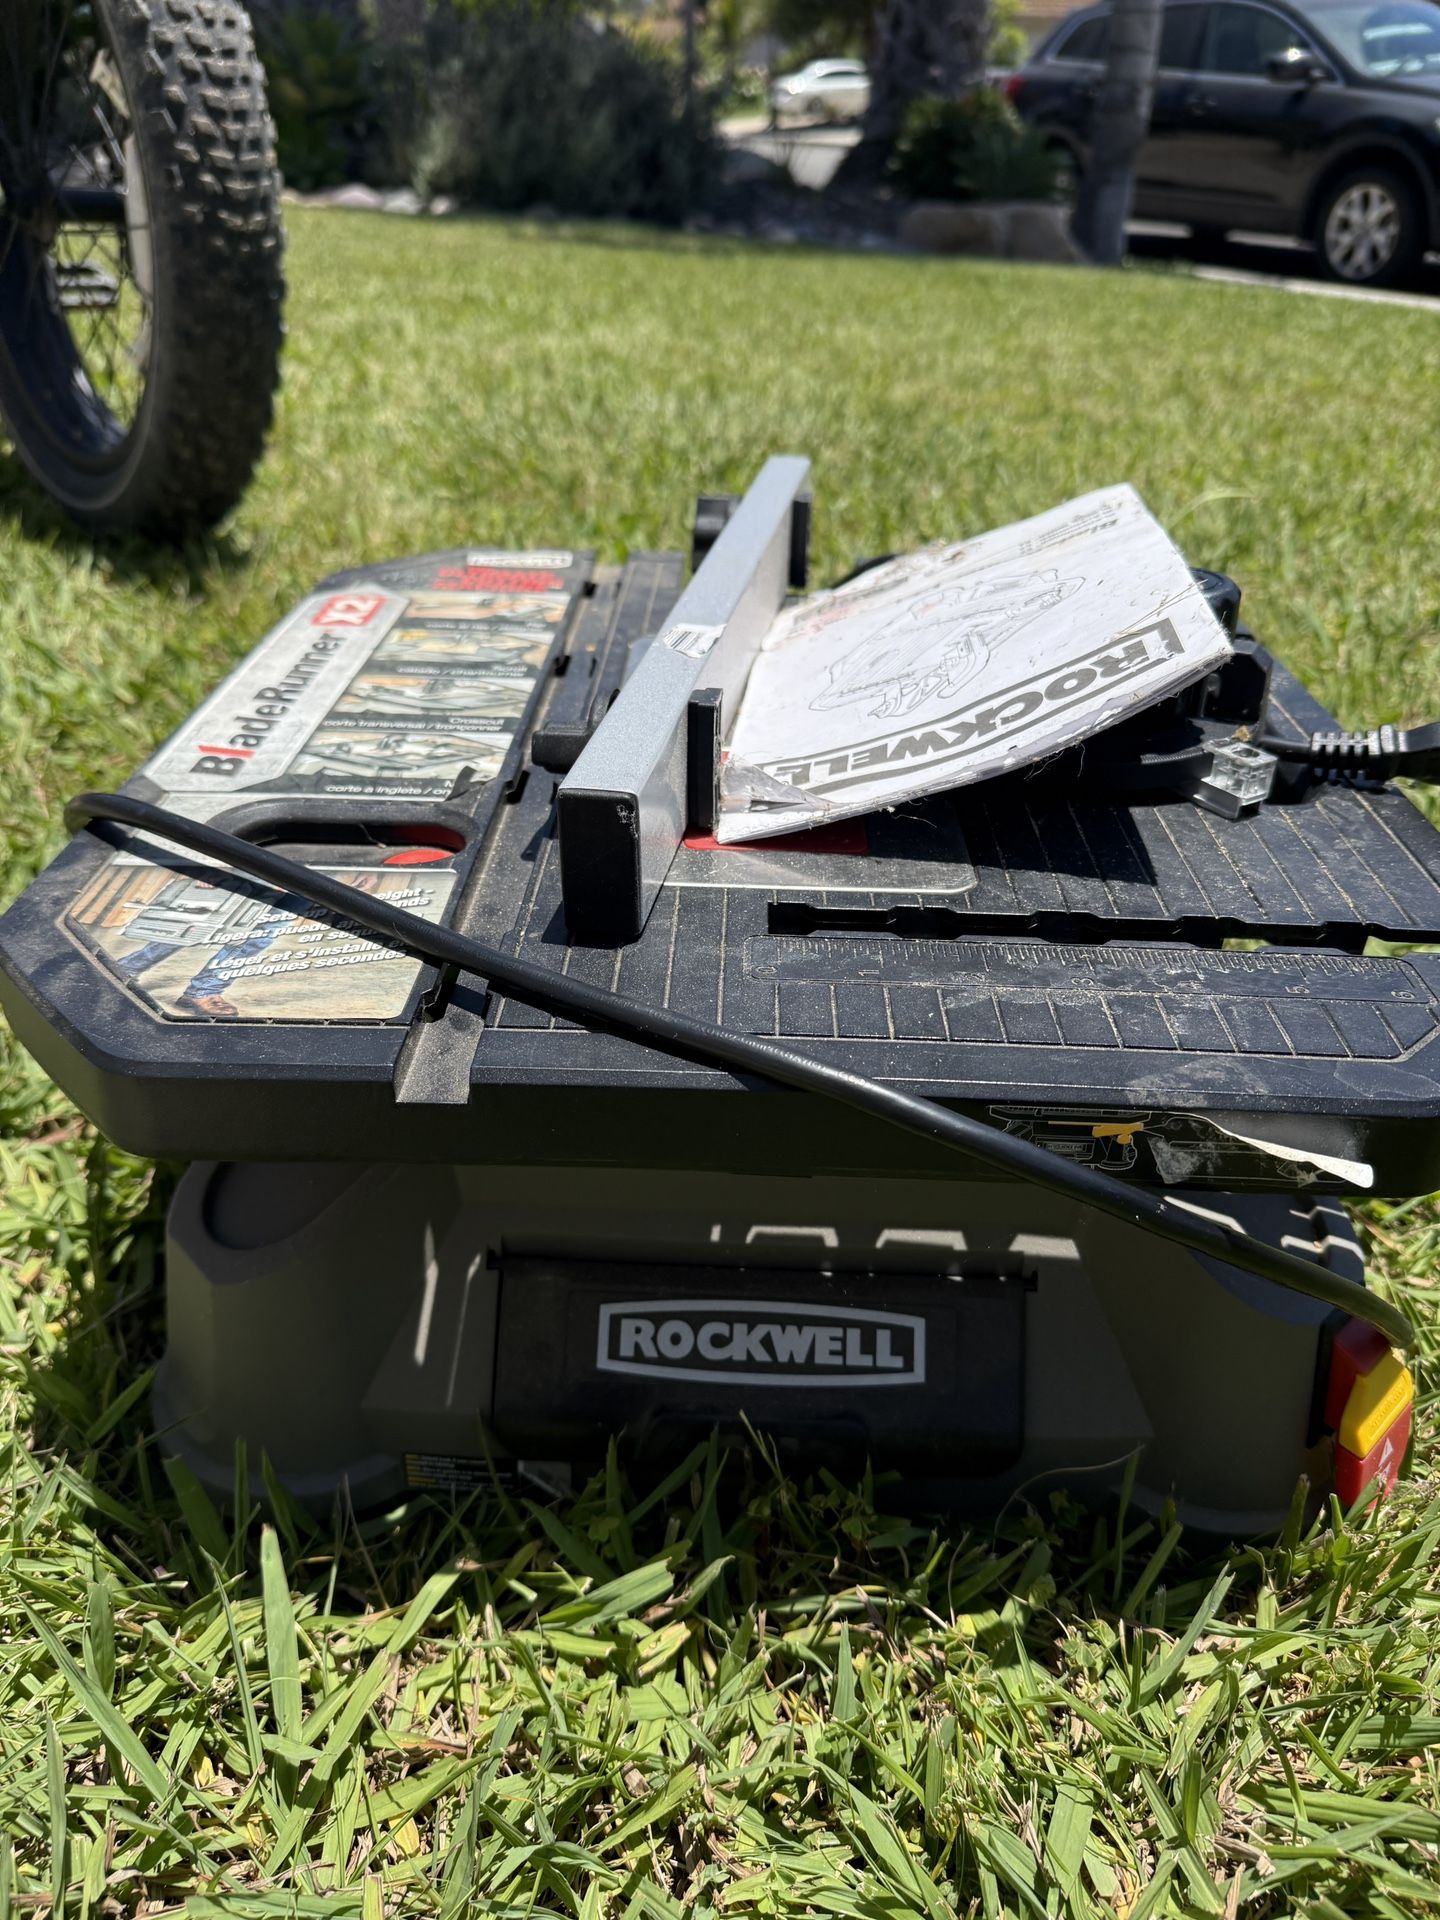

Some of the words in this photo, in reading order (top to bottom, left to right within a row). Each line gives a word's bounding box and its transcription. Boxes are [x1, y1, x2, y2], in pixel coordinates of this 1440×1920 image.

[189, 633, 347, 776] BladeRunner
[775, 639, 1150, 787] ROCKWELL
[325, 784, 361, 793] corte
[257, 908, 298, 925] Sets
[203, 925, 270, 944] Ligera:
[273, 919, 331, 938] puede
[300, 933, 325, 945] en
[209, 953, 267, 970] Léger
[272, 951, 292, 962] et
[296, 942, 383, 959] s'installe
[219, 962, 310, 980] quelques
[314, 950, 406, 967] secondes
[618, 1317, 905, 1369] ROCKWELL
